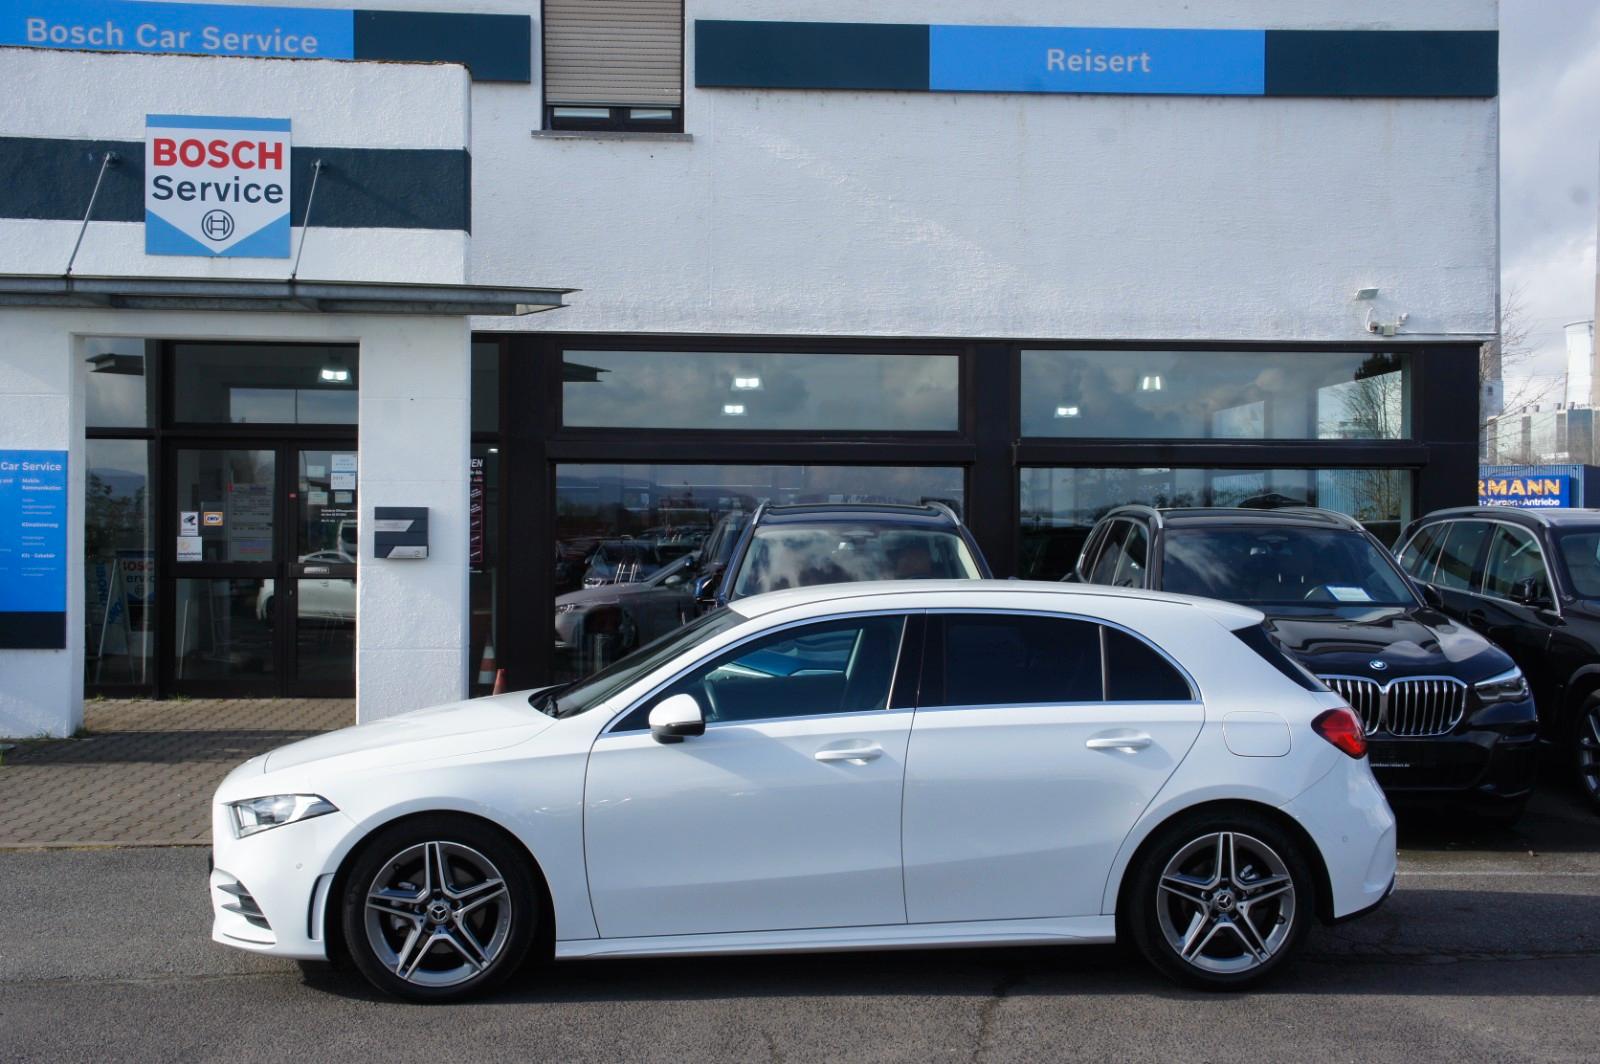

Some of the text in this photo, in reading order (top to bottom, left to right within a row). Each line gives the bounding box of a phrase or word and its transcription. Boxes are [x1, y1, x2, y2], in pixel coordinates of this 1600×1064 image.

[26, 18, 318, 53] Bosch Car Service
[1046, 48, 1151, 73] Reisert
[153, 138, 283, 170] BOSCH
[152, 174, 284, 204] Service
[0, 462, 62, 471] Car Service
[1523, 497, 1560, 507] Antriebe
